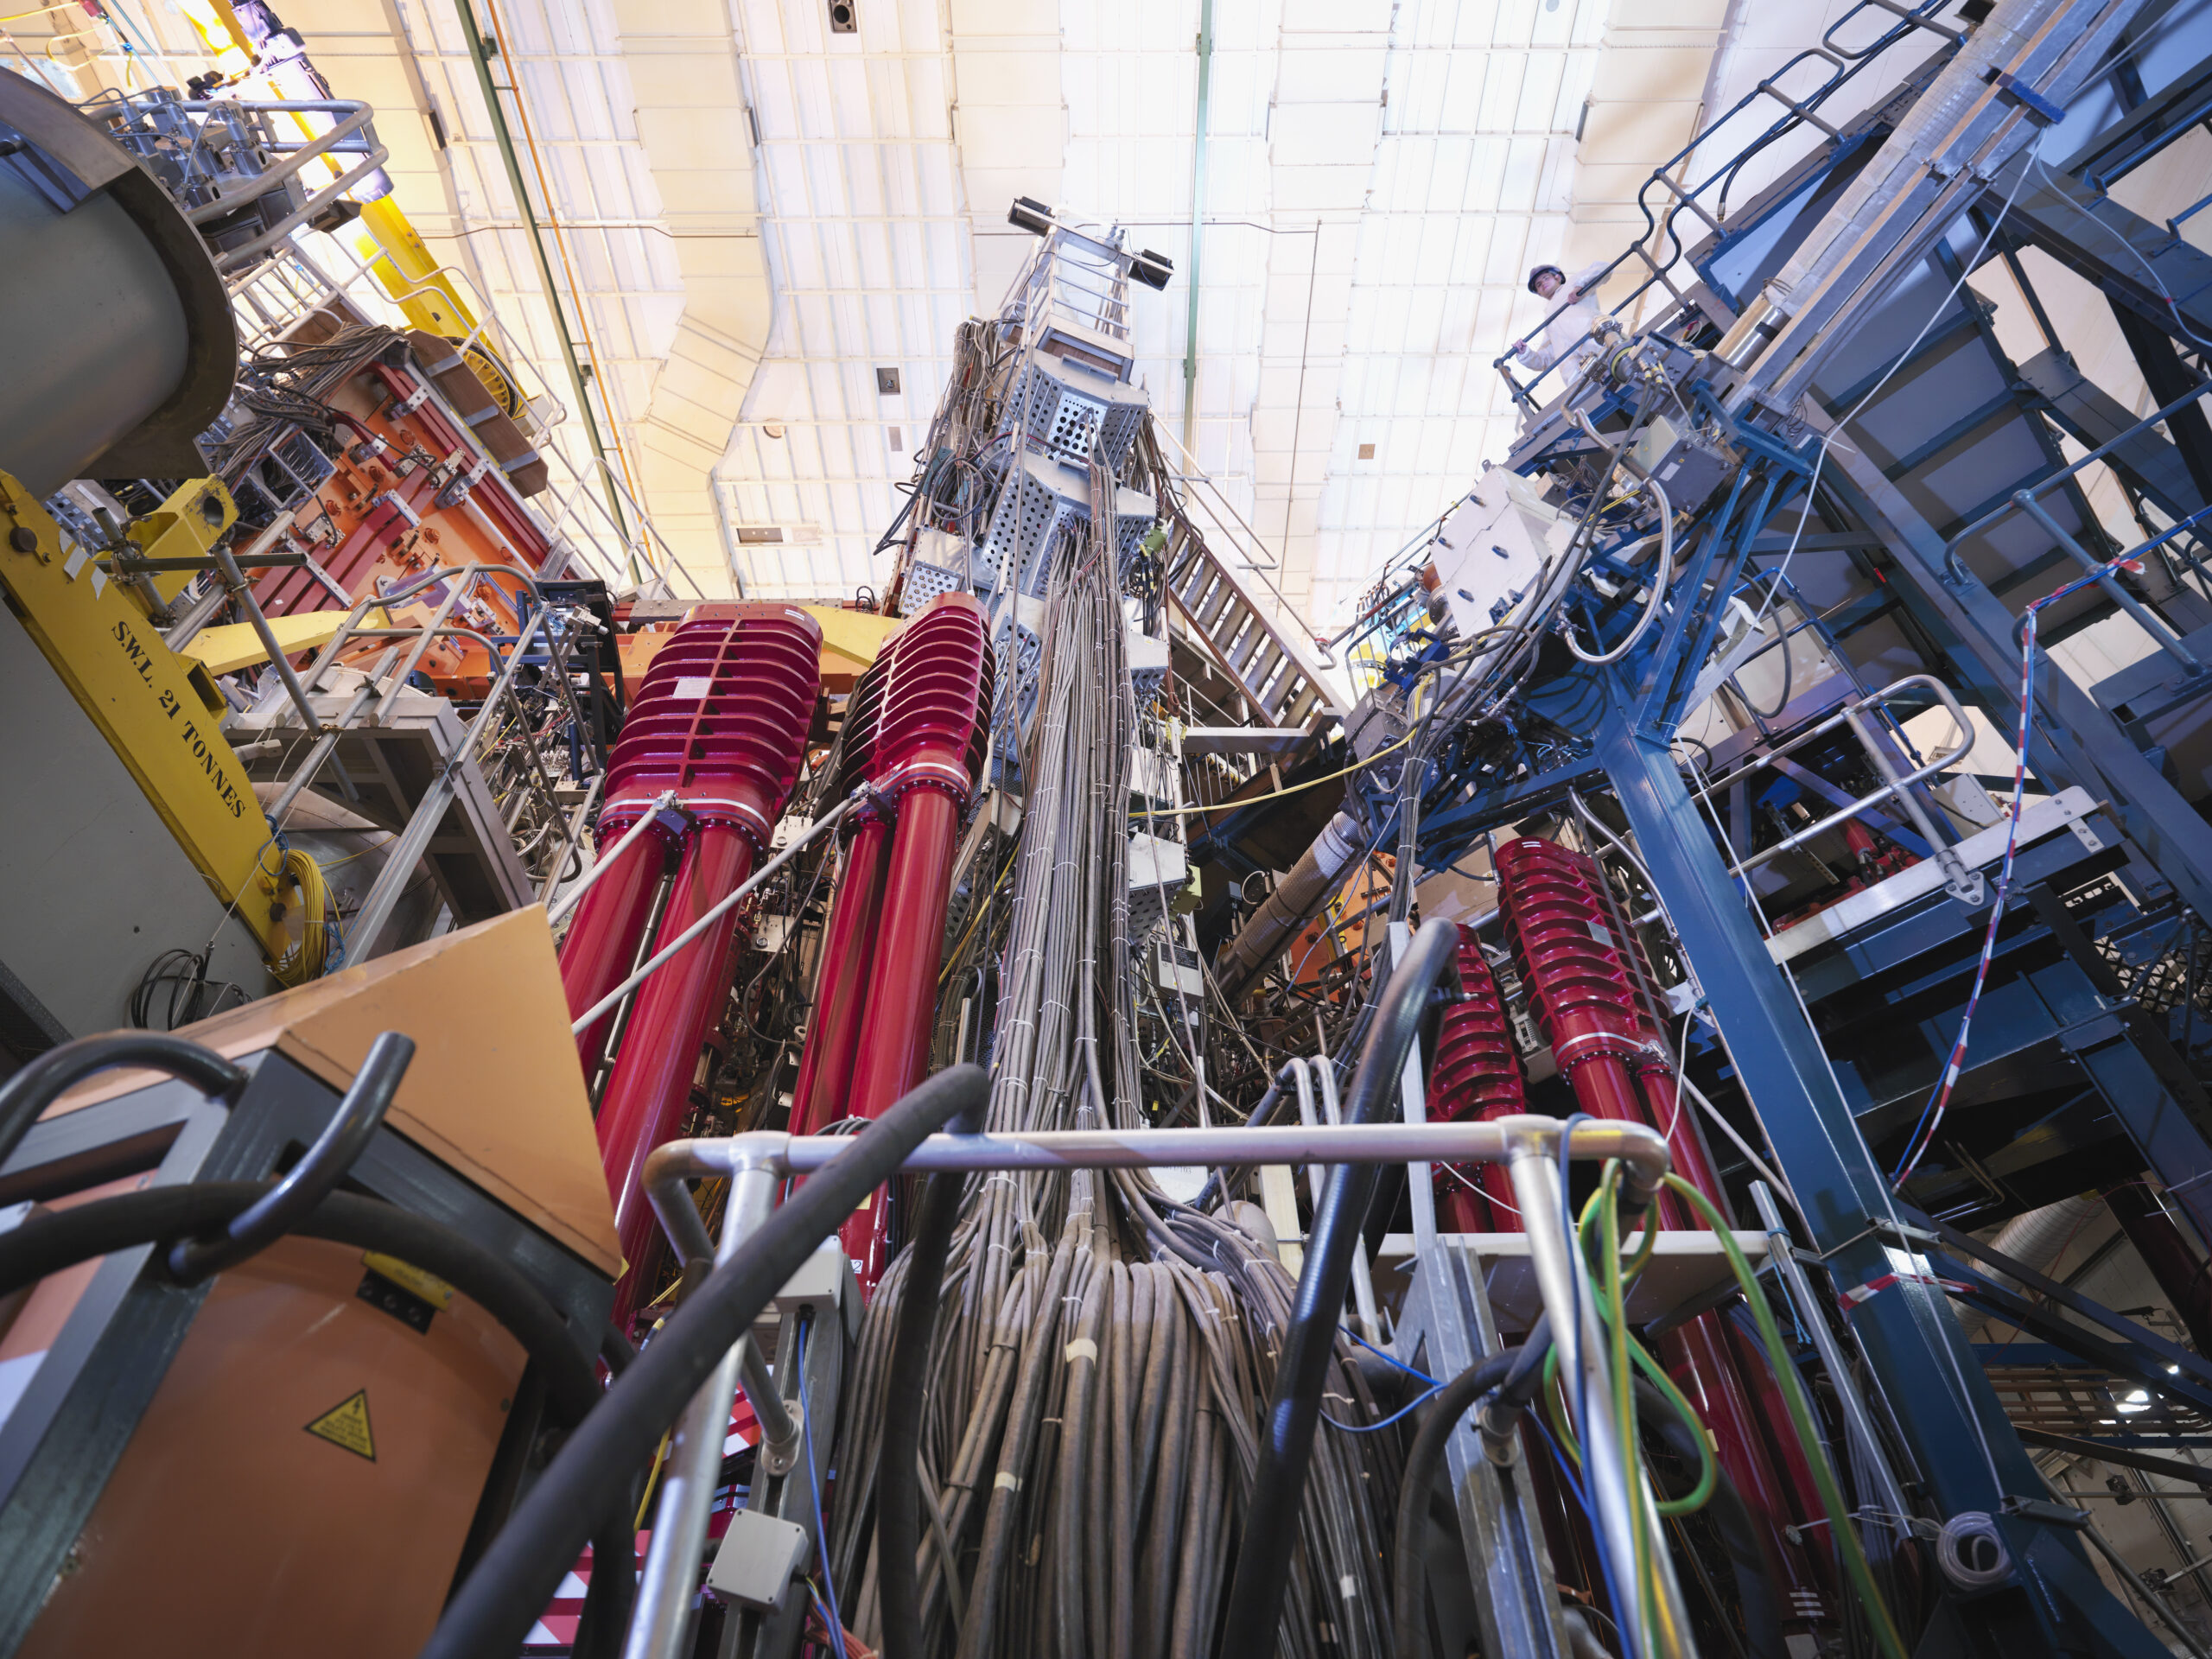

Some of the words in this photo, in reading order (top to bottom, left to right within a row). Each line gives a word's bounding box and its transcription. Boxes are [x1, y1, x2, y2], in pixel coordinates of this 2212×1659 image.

[111, 620, 153, 689] S.W.L.
[157, 690, 181, 720] 21
[181, 720, 246, 818] TONNES
